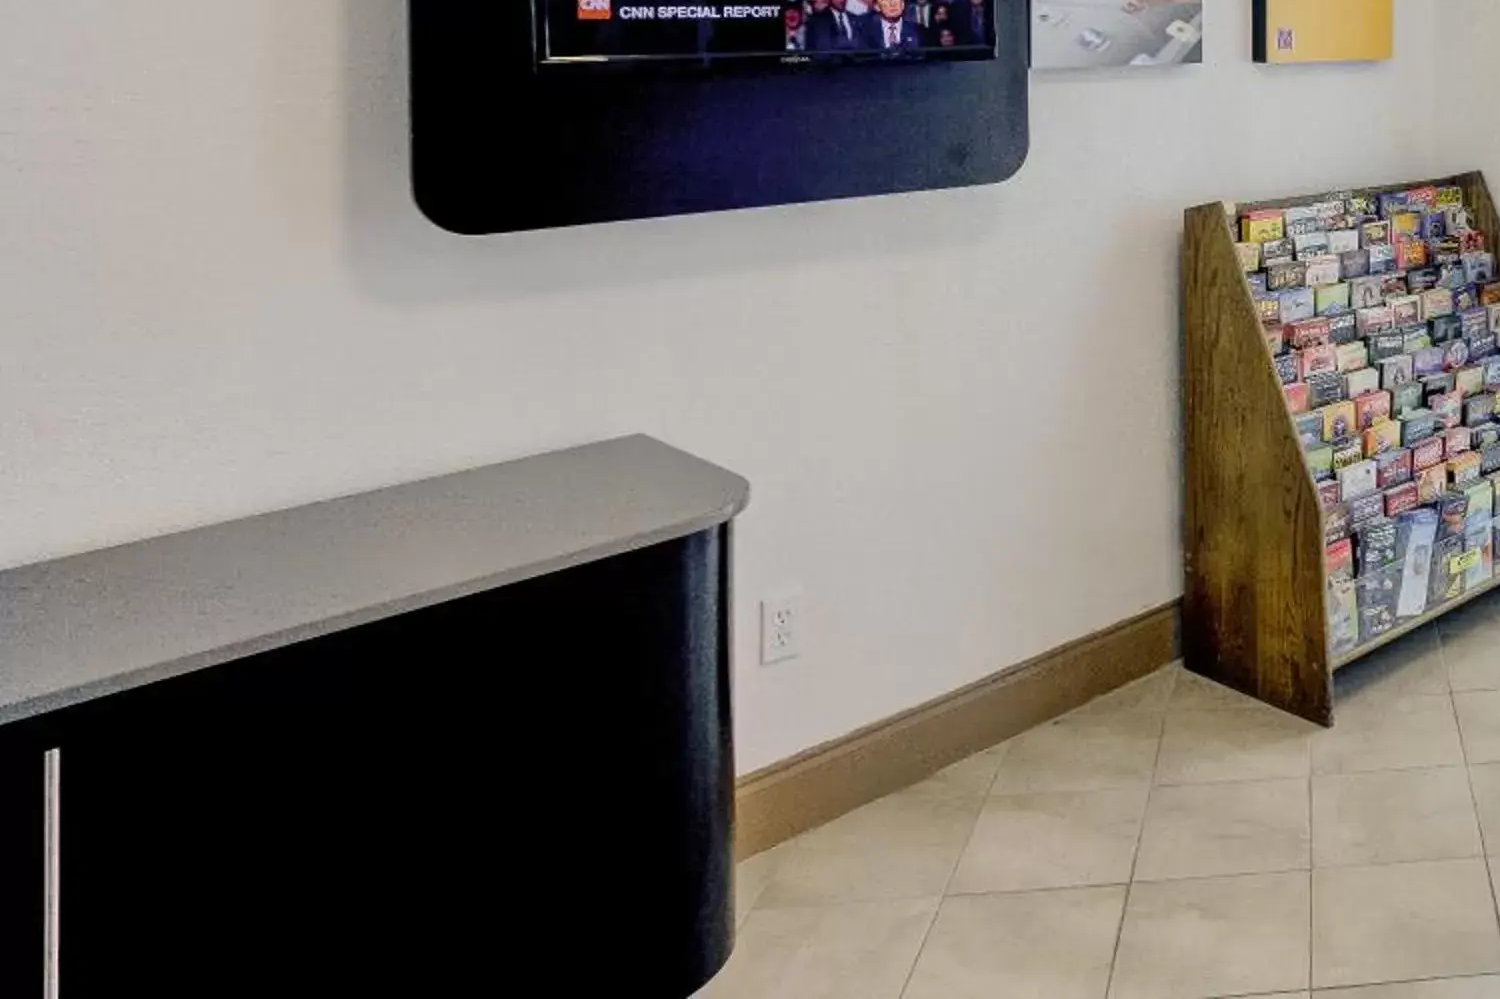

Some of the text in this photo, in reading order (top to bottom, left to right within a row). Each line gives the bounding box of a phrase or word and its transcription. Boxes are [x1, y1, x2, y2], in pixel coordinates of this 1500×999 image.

[620, 6, 780, 19] CNN SPECIAL REPORT
